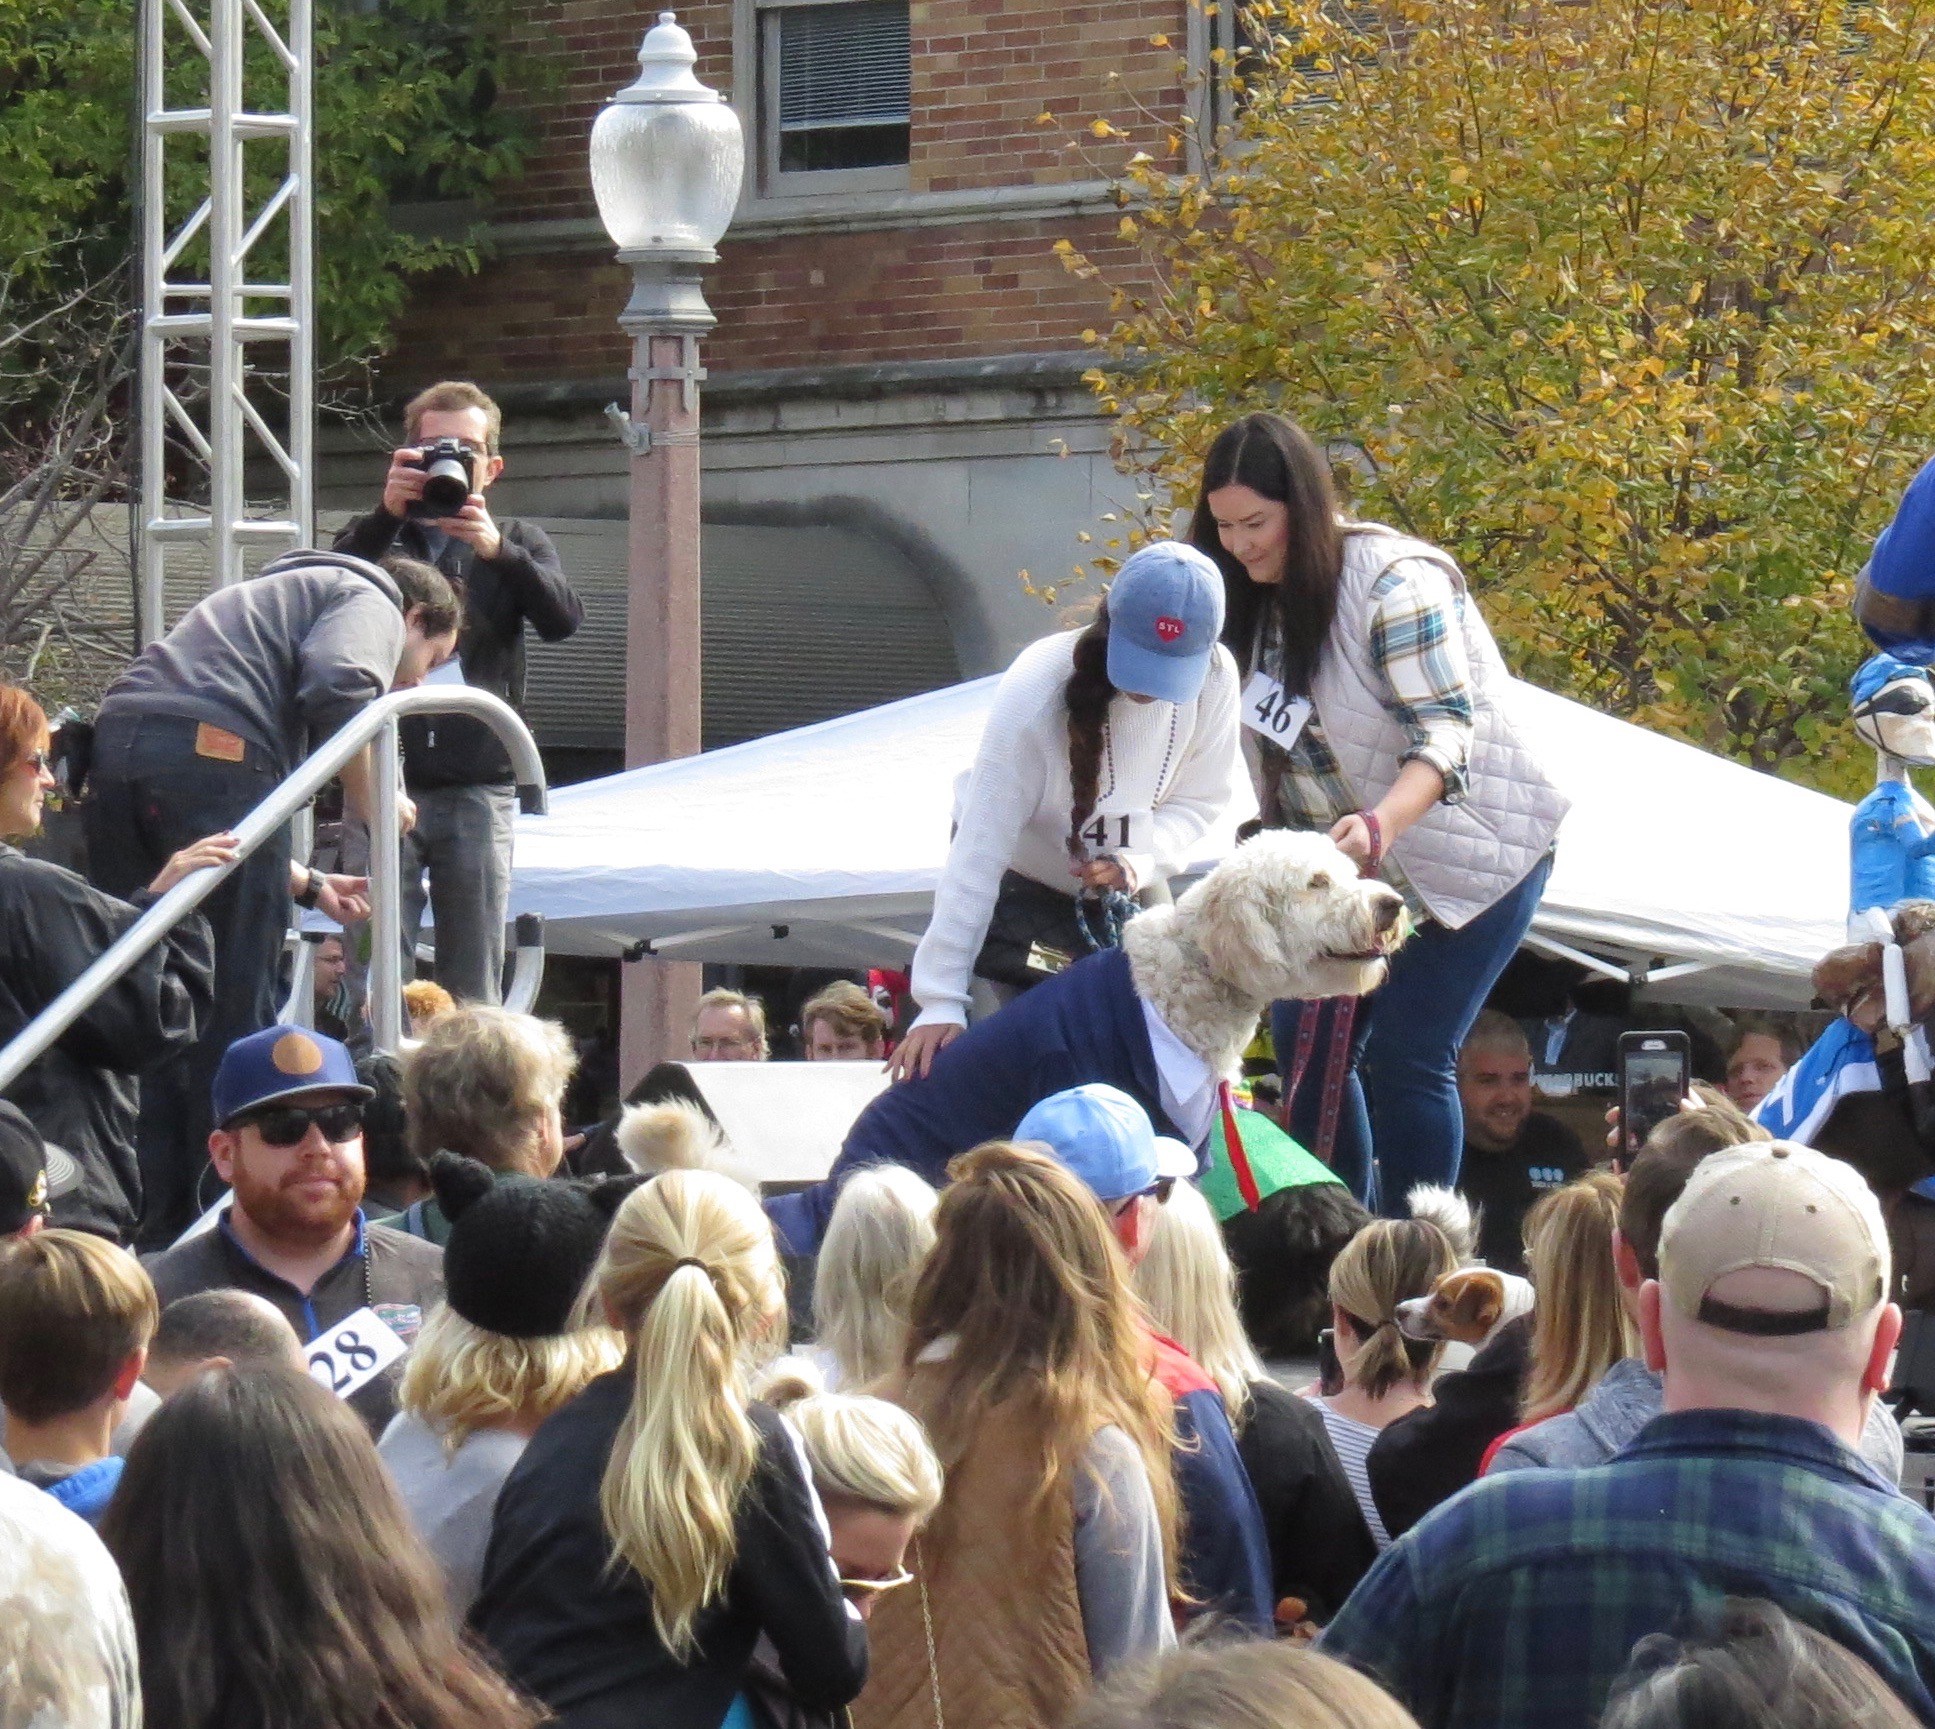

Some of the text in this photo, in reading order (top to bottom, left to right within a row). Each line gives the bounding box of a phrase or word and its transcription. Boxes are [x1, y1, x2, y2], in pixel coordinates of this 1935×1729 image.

[1158, 621, 1180, 634] STL
[1254, 690, 1298, 734] 46
[1082, 813, 1132, 849] 41
[308, 1330, 378, 1392] 28
